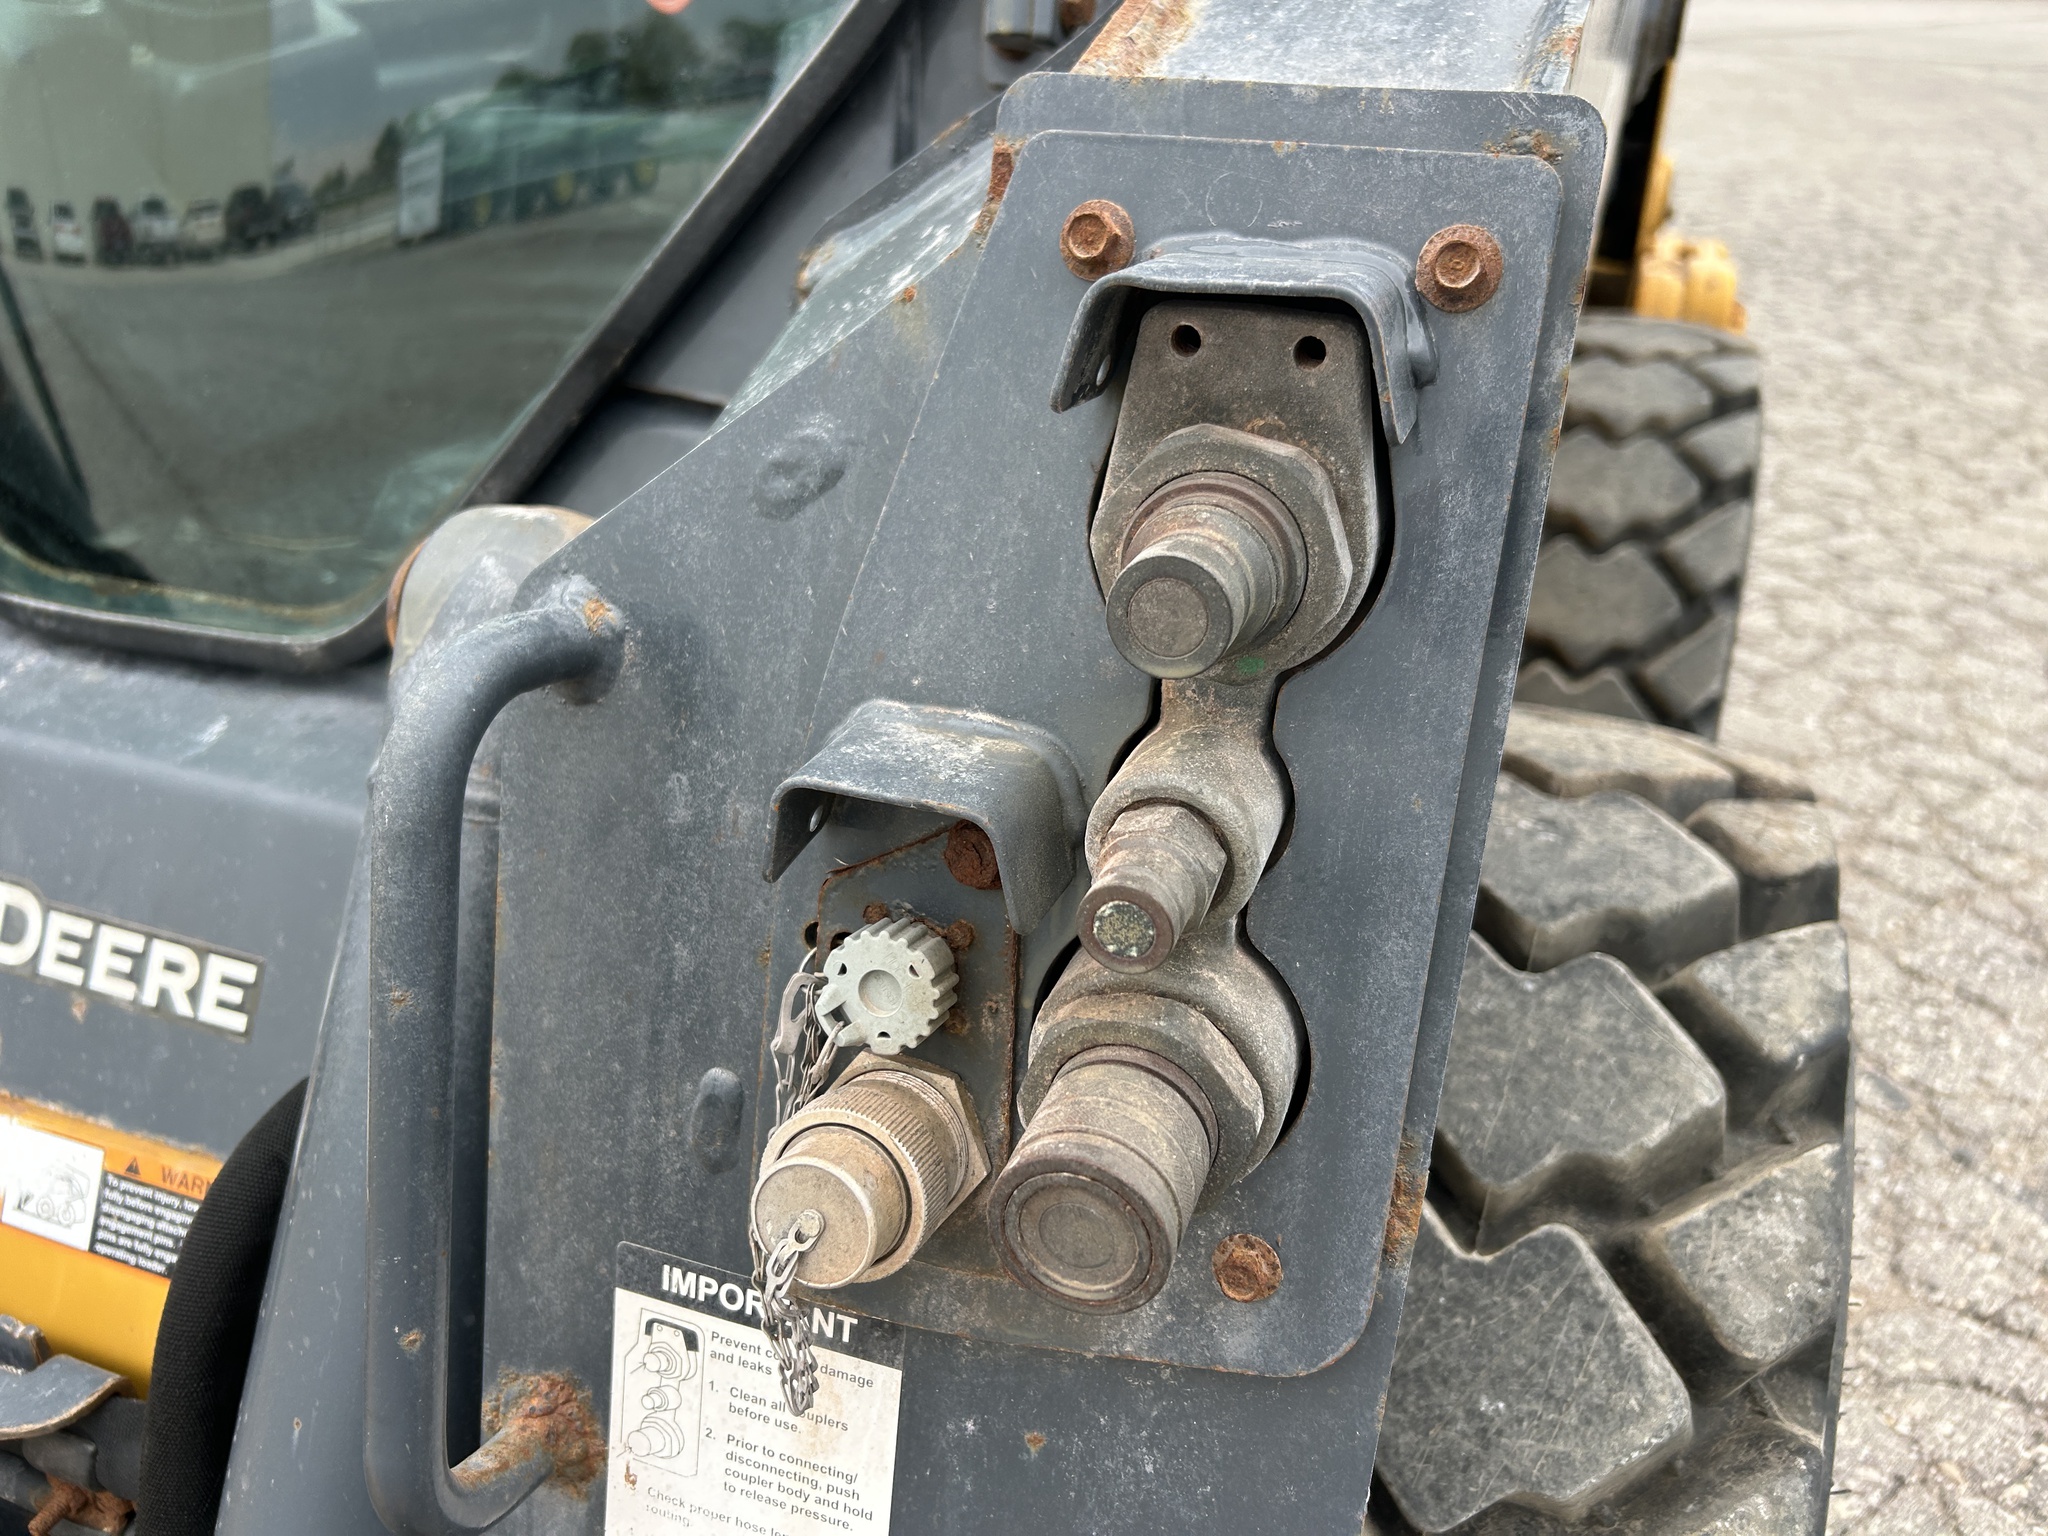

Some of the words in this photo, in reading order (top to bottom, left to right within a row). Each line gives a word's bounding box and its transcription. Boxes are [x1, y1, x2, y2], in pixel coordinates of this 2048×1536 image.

[0, 881, 258, 1033] DEERE
[103, 1187, 124, 1205] fully
[125, 1194, 154, 1213] before
[154, 1205, 194, 1226] engagin
[107, 1173, 119, 1187] To
[120, 1180, 153, 1199] prevent
[154, 1190, 182, 1210] injury,
[98, 1215, 153, 1242] engagement
[101, 1201, 156, 1230] disengaging
[94, 1241, 137, 1266] operating
[138, 1254, 168, 1275] loader.
[96, 1229, 117, 1244] pins
[118, 1236, 133, 1249] are
[133, 1239, 154, 1257] fully
[662, 1264, 858, 1343] IMPORNT
[709, 1349, 734, 1365] and
[738, 1355, 773, 1376] leaks
[711, 1330, 762, 1356] Prevent
[819, 1364, 874, 1389] damage
[708, 1380, 719, 1393] 1.
[729, 1386, 767, 1408] Clean
[770, 1399, 787, 1413] all
[728, 1401, 771, 1424] before
[774, 1417, 802, 1434] use.
[705, 1427, 717, 1441] 2.
[726, 1433, 759, 1453] Prior
[762, 1445, 775, 1458] to
[779, 1451, 858, 1486] connecting/
[725, 1450, 823, 1491] disconnecting,
[826, 1483, 860, 1501] push
[647, 1486, 686, 1509] Check
[689, 1503, 732, 1524] proper
[735, 1516, 767, 1536] hose
[723, 1481, 736, 1494] to
[740, 1487, 787, 1510] release
[790, 1503, 854, 1532] pressure.
[724, 1467, 774, 1490] coupler
[777, 1481, 811, 1503] body
[814, 1495, 839, 1511] and
[843, 1501, 873, 1522] hold
